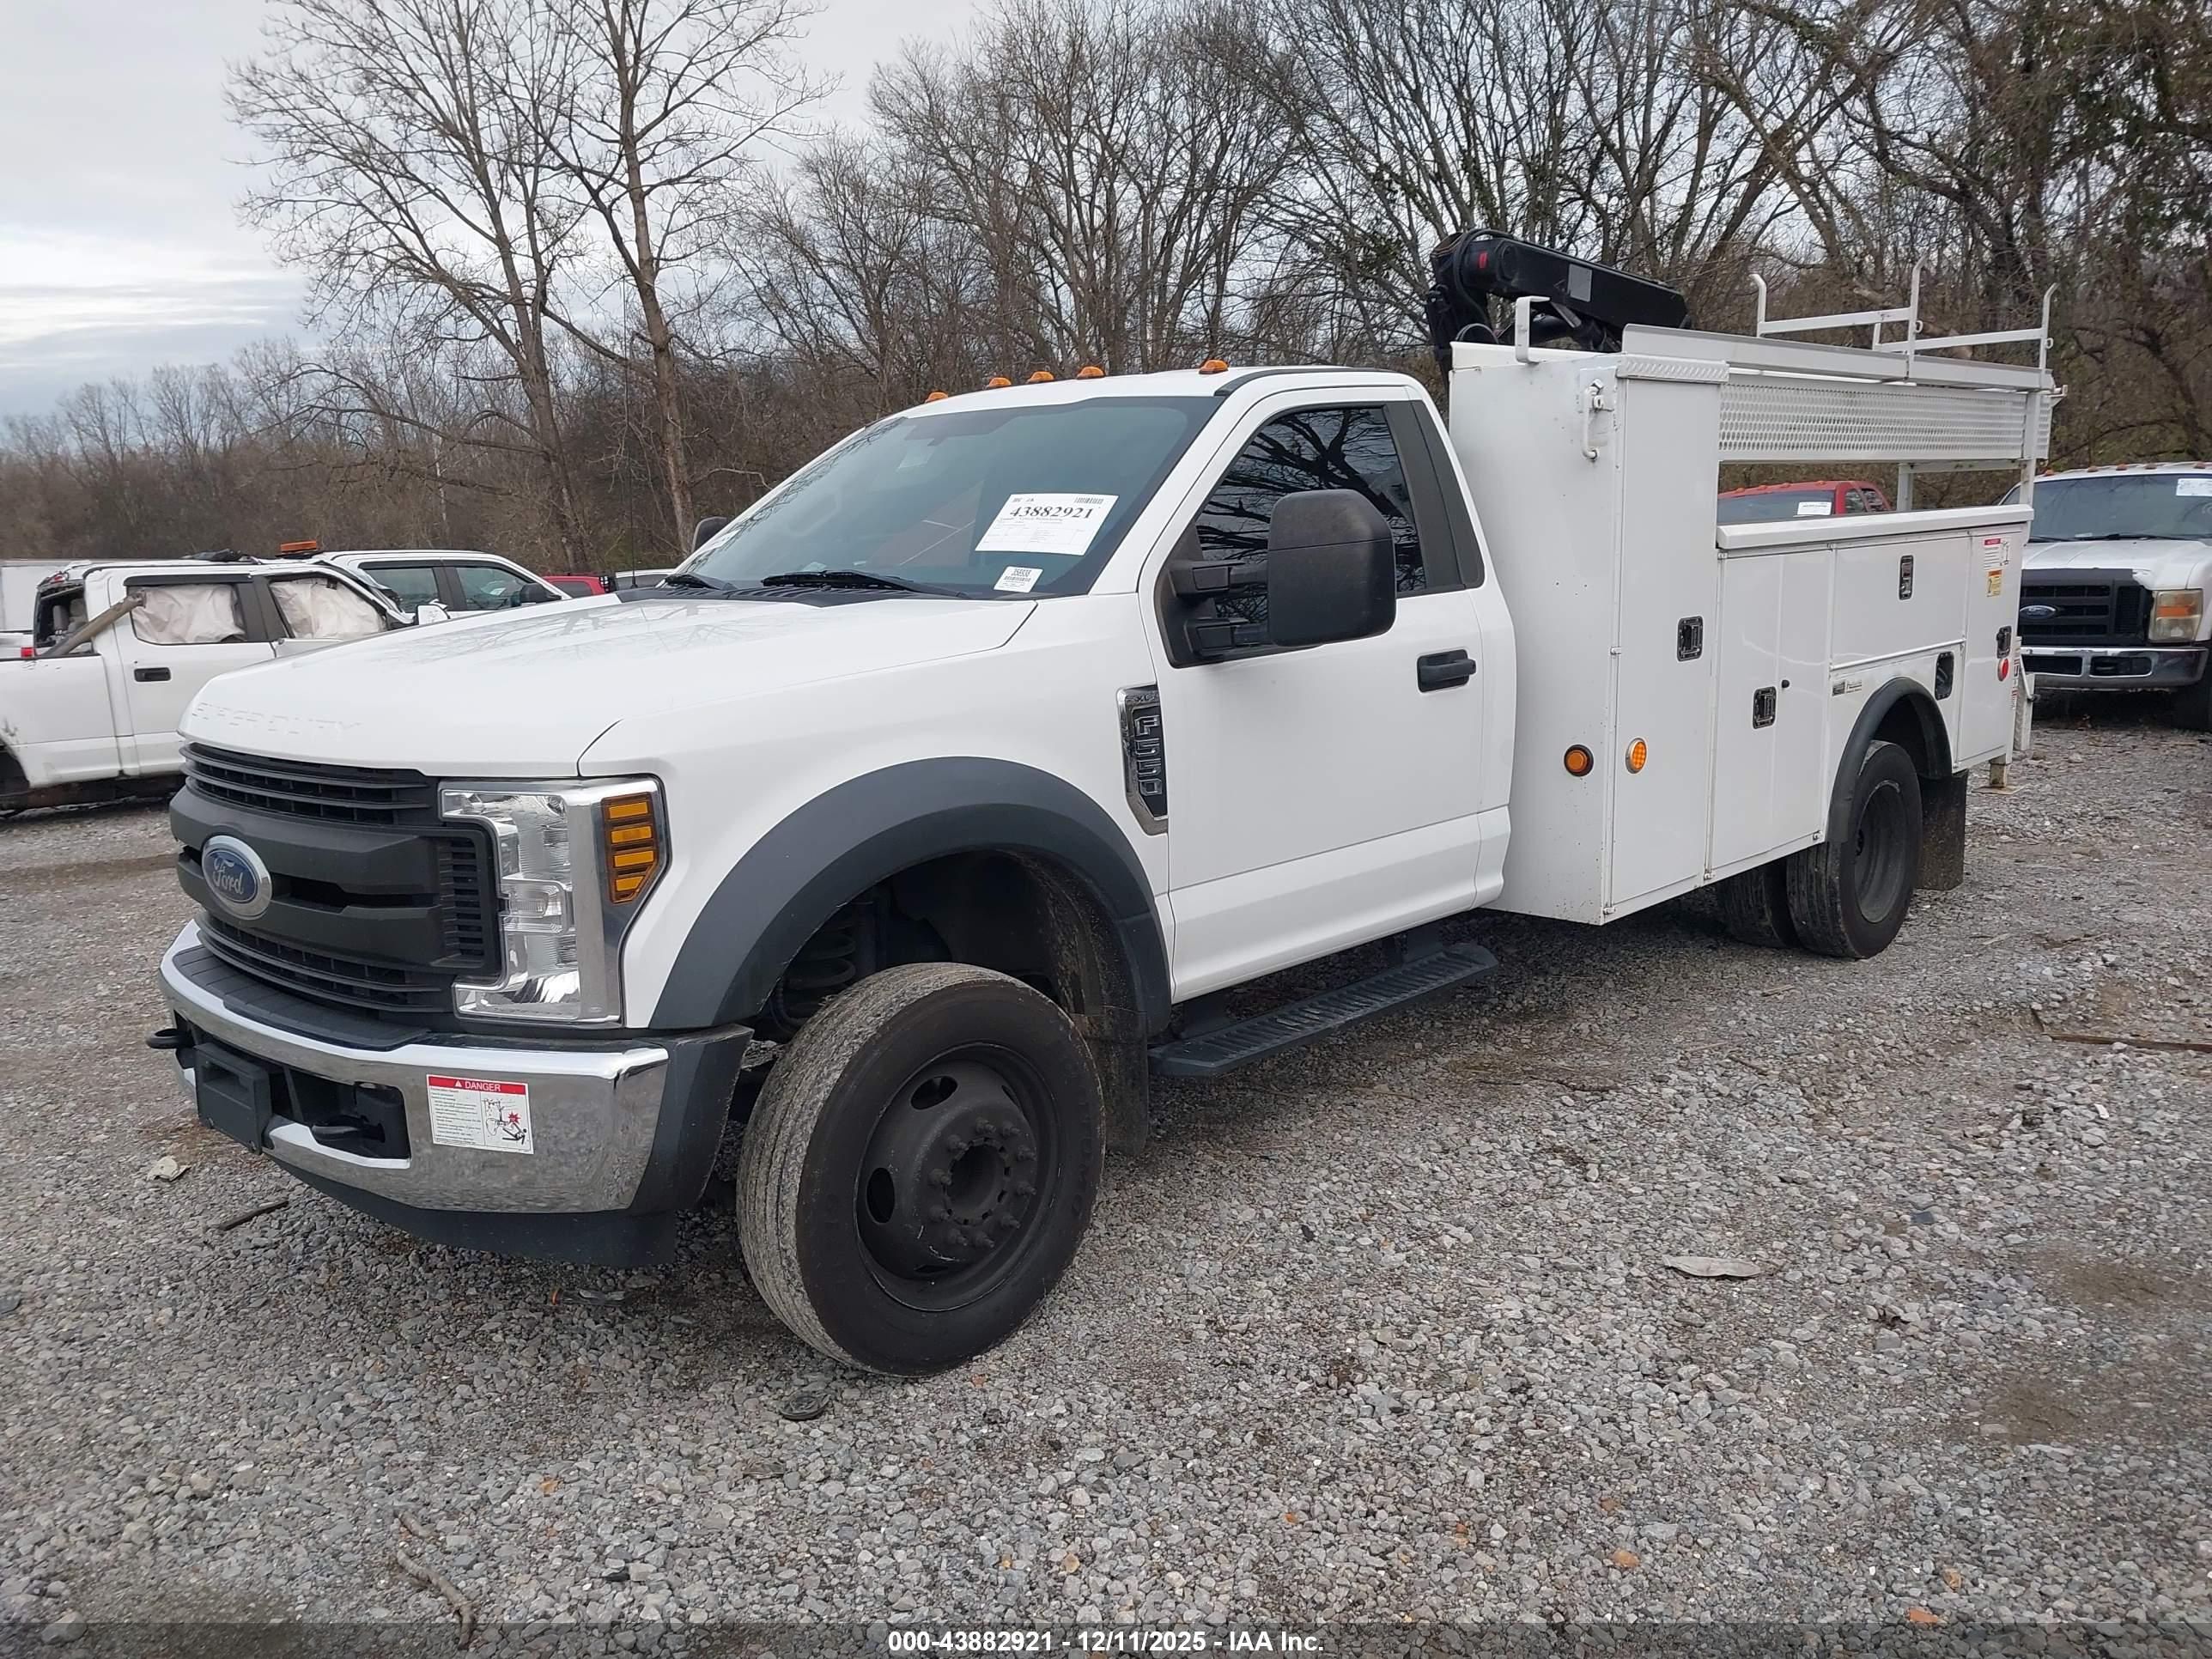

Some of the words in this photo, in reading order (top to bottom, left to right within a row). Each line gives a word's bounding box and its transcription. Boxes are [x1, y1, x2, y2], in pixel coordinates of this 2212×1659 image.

[1010, 506, 1094, 519] 43882921
[212, 858, 245, 895] Ford
[465, 1080, 501, 1092] DANGER
